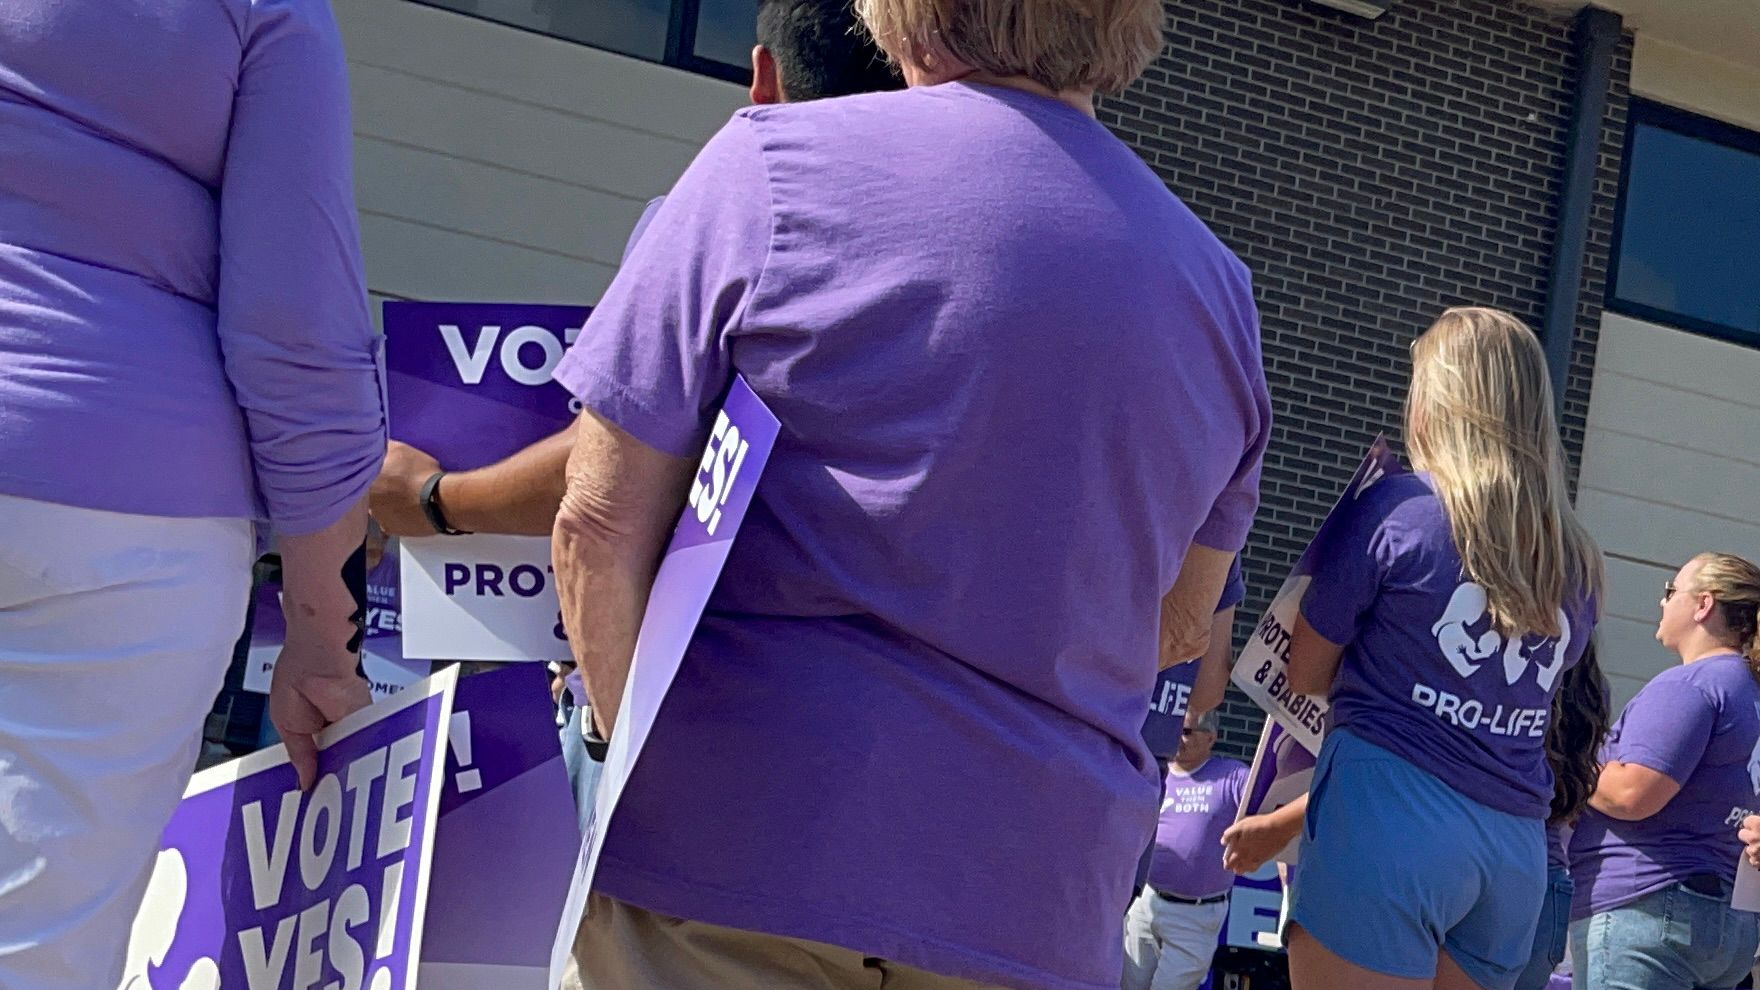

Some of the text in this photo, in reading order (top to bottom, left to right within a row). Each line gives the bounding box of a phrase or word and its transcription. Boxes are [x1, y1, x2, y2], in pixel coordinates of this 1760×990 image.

[438, 325, 581, 386] VO
[444, 563, 554, 597] PRO
[1412, 683, 1547, 737] PRO-LIFE
[1175, 786, 1213, 797] VALUE
[242, 730, 424, 909] VOTE
